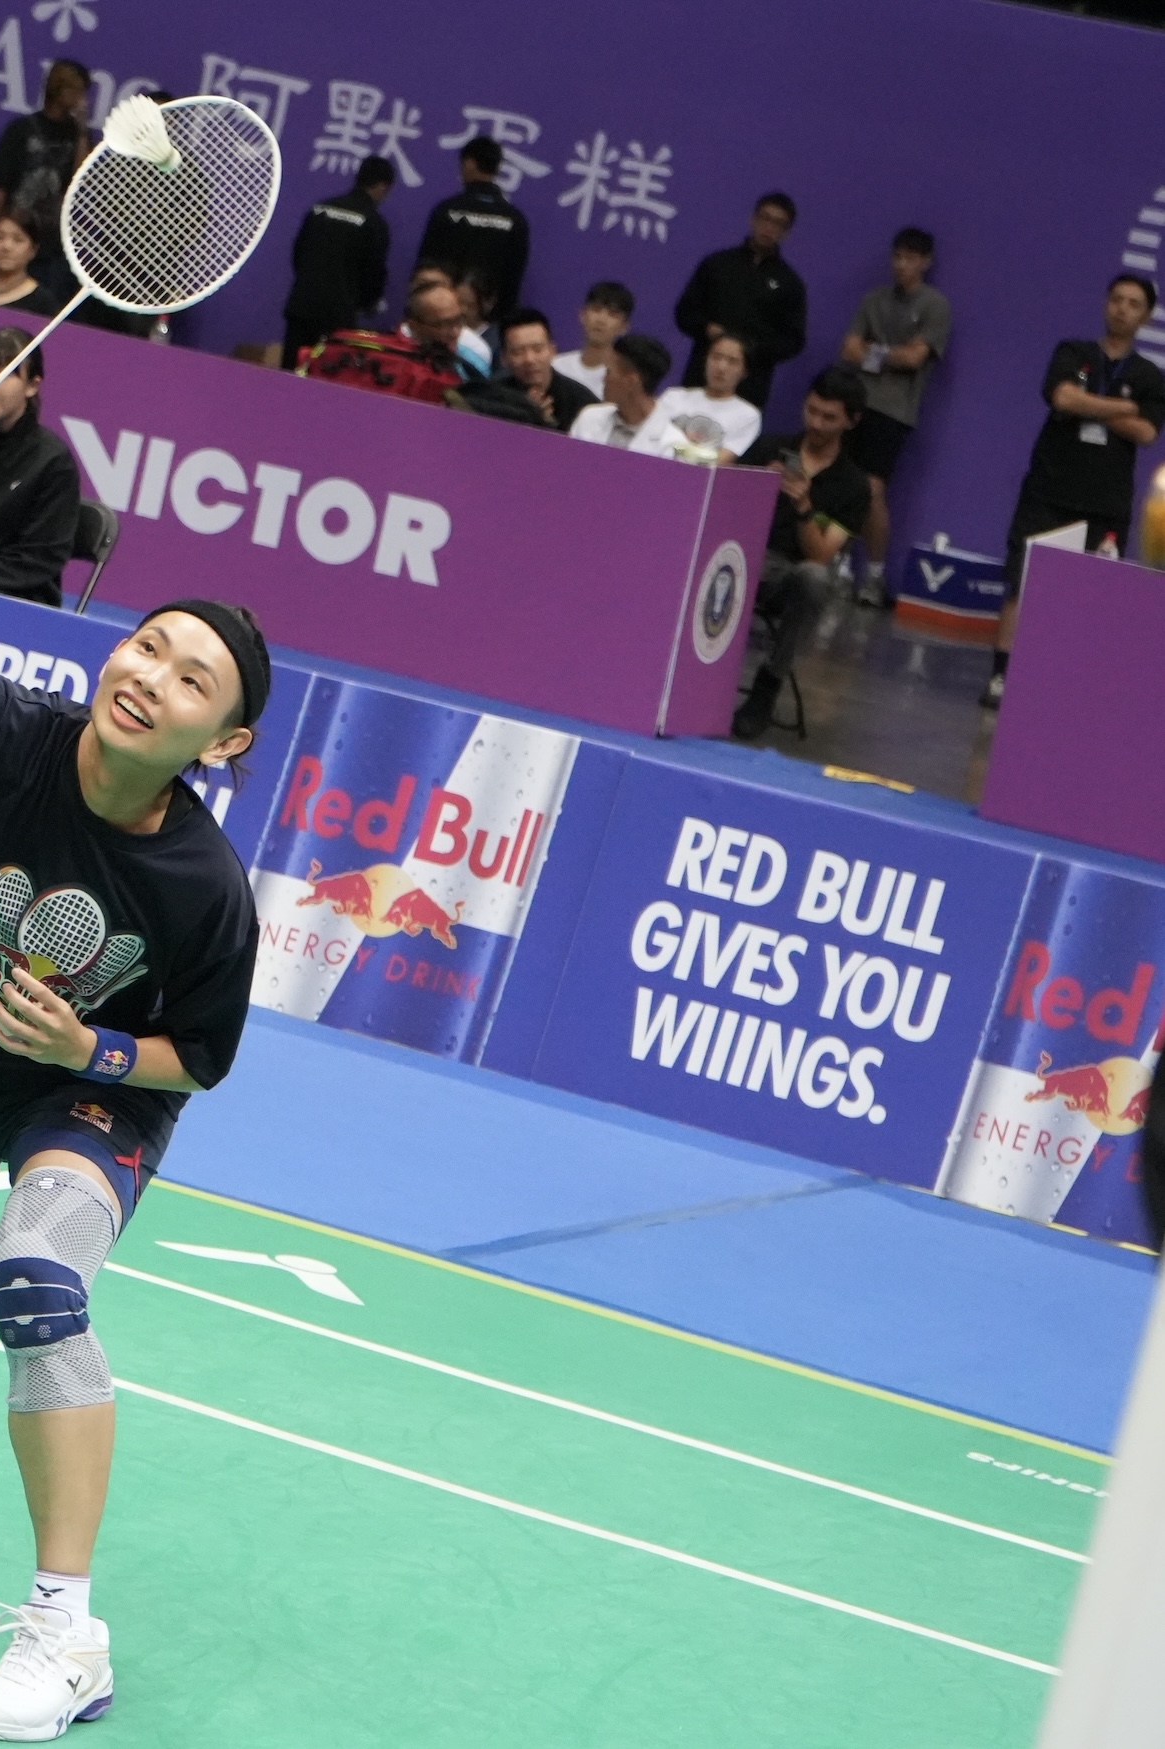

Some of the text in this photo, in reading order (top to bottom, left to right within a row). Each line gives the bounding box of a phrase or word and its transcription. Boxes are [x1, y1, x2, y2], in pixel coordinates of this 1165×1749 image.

[201, 54, 678, 244] 阿默蛋糕
[61, 416, 452, 587] VICTOR
[280, 755, 418, 854] Red
[413, 787, 545, 888] Bull
[666, 816, 946, 955] RED BULL
[257, 917, 482, 1001] NERGY DRINK
[631, 901, 951, 1042] GIVES YOU
[1005, 939, 1155, 1045] Red
[631, 986, 886, 1124] WIIINGS.
[973, 1112, 1113, 1172] ENERGY
